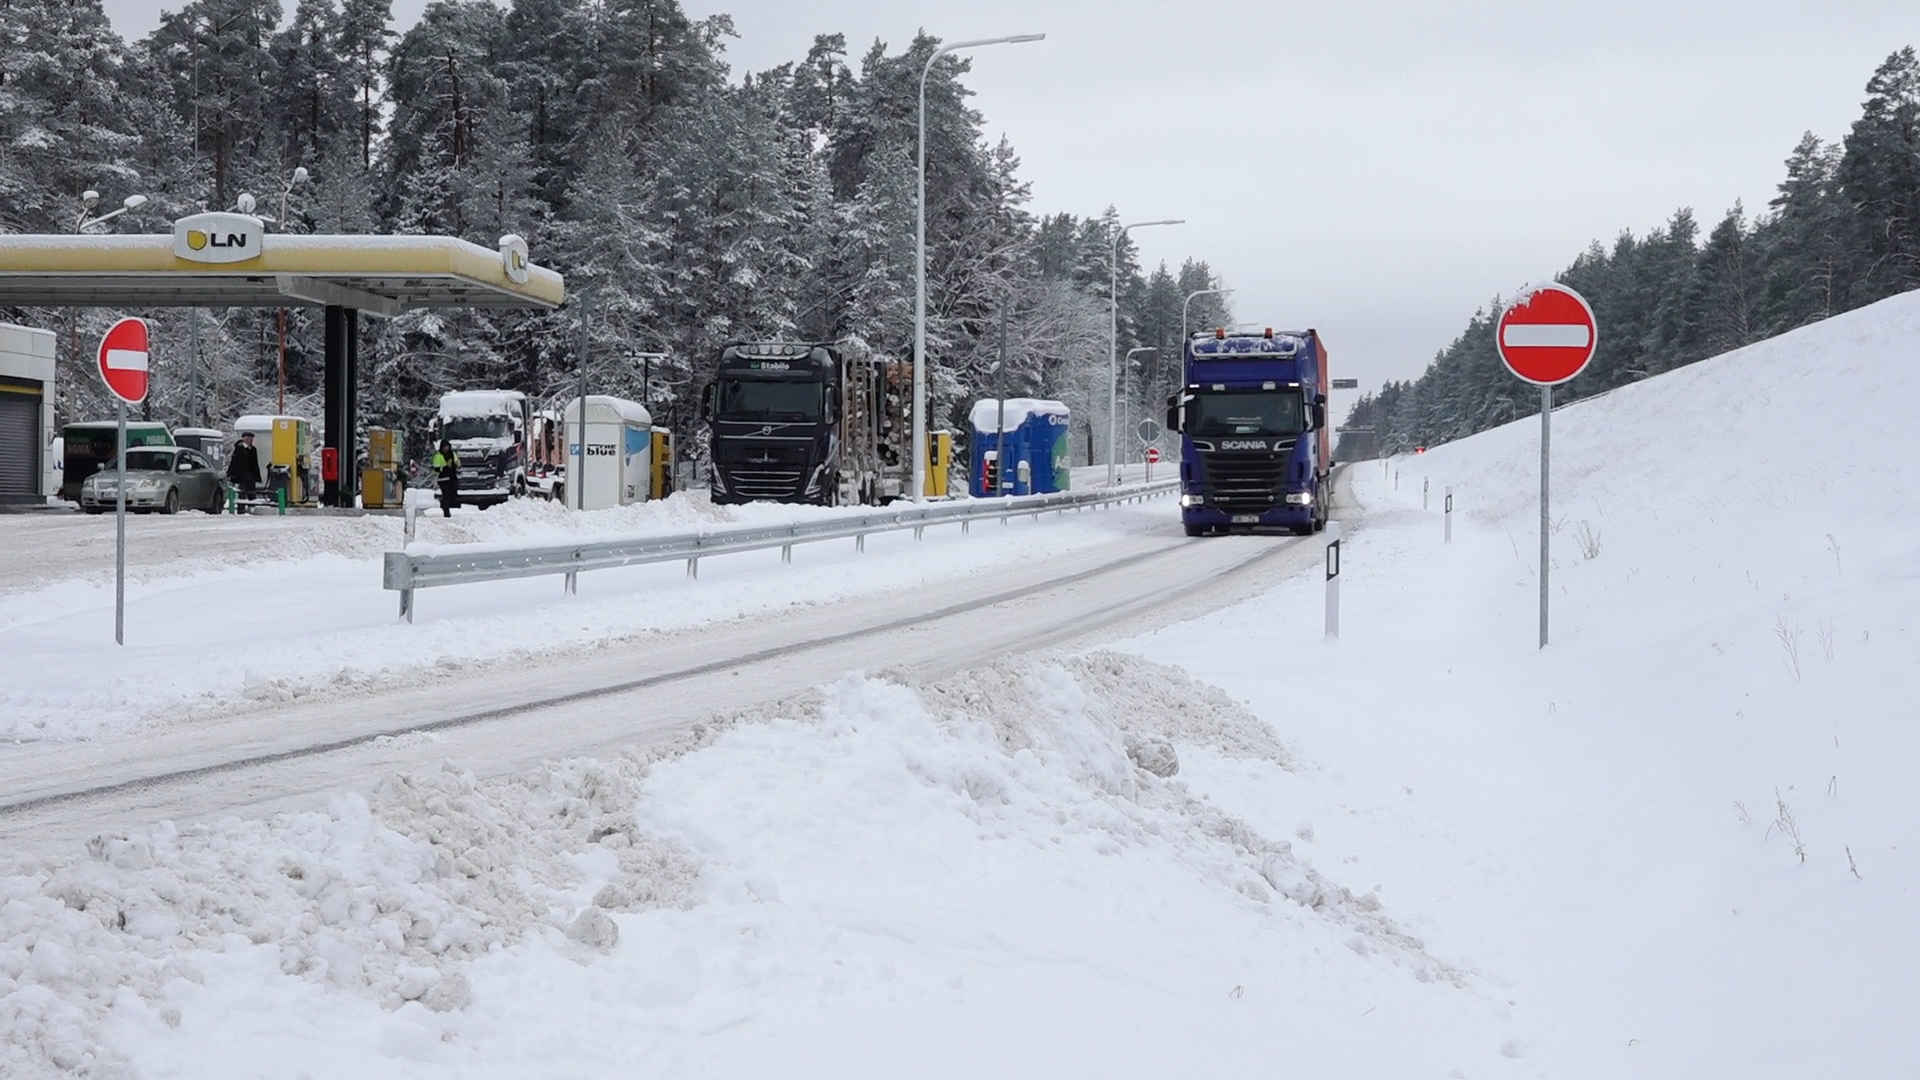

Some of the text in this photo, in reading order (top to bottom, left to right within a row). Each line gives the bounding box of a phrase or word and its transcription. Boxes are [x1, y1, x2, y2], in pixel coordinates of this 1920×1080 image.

[760, 361, 790, 370] Stabilo
[1221, 440, 1267, 450] SCANIA
[587, 447, 616, 456] blue
